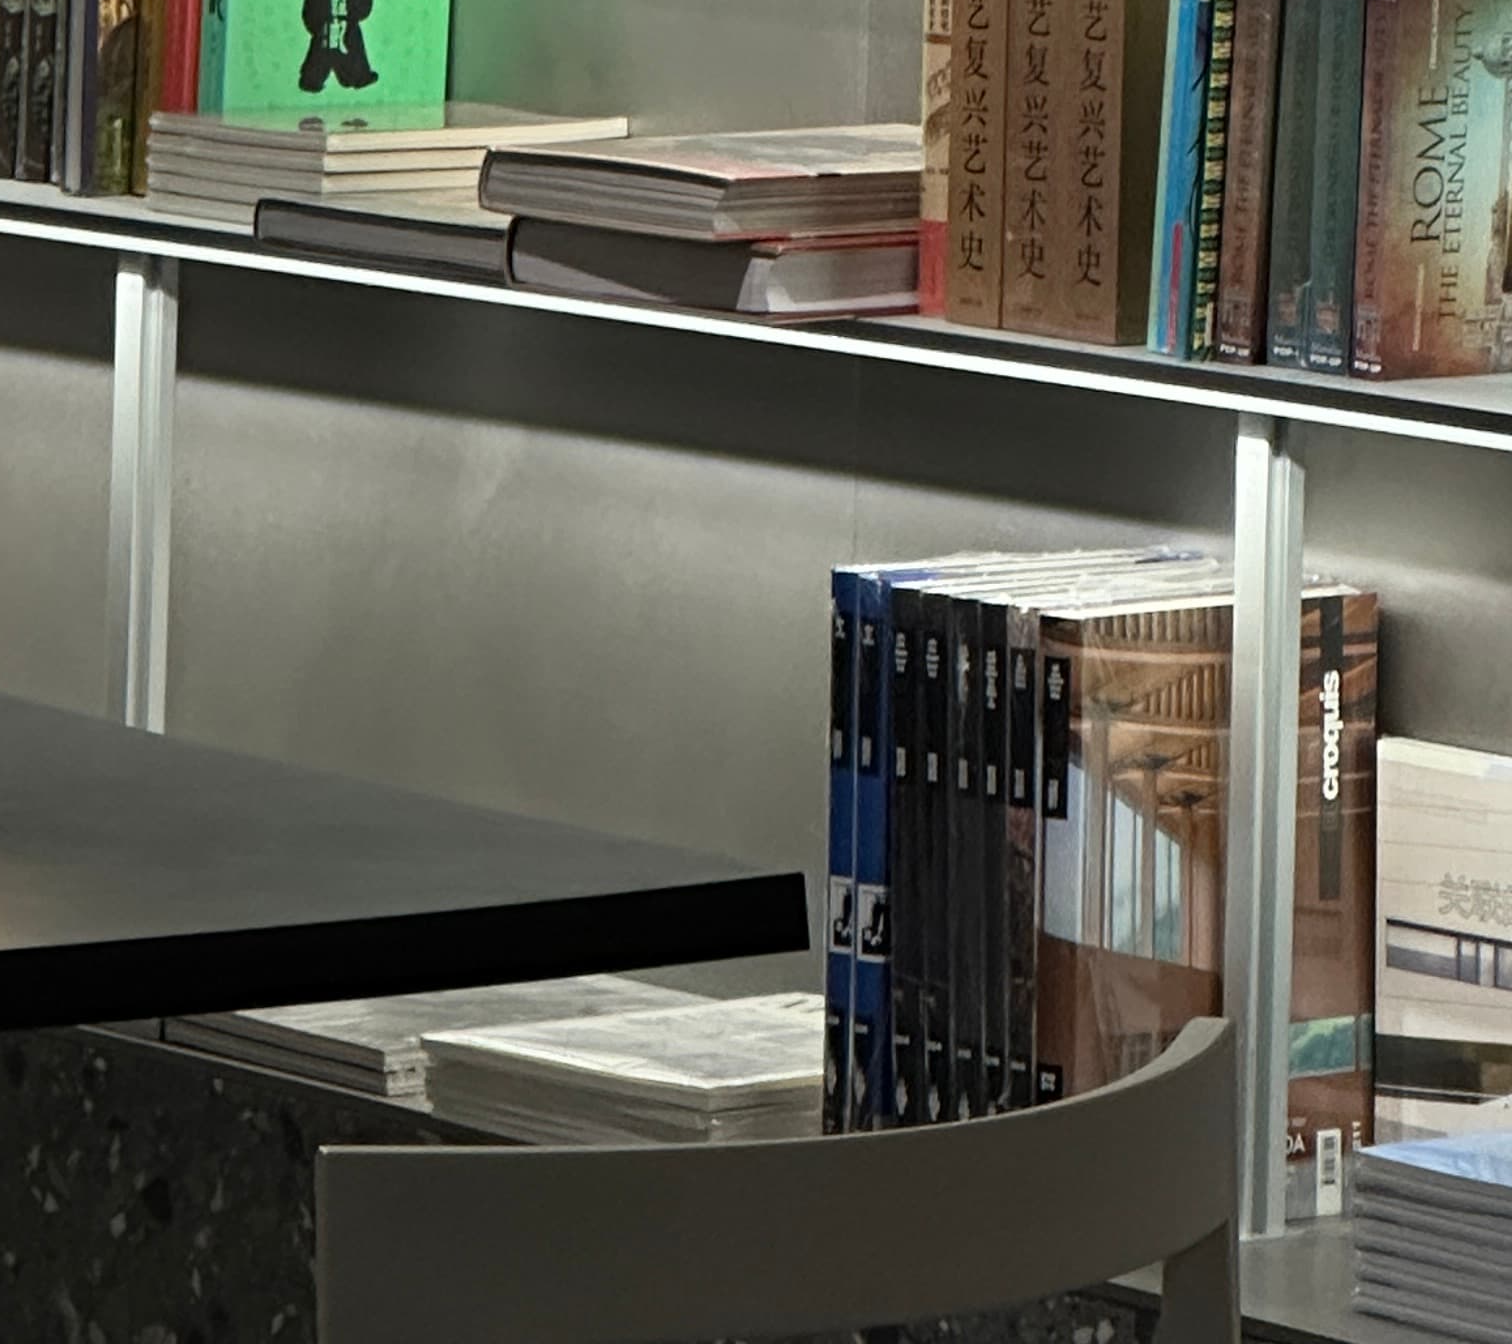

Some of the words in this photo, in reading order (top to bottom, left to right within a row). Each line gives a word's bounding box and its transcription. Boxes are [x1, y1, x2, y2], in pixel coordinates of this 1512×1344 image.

[1447, 3, 1474, 115] BEAUTY
[1409, 85, 1449, 244] ROME
[1441, 123, 1468, 254] ETERNAL
[1437, 264, 1459, 320] THE
[1319, 669, 1345, 801] croquis
